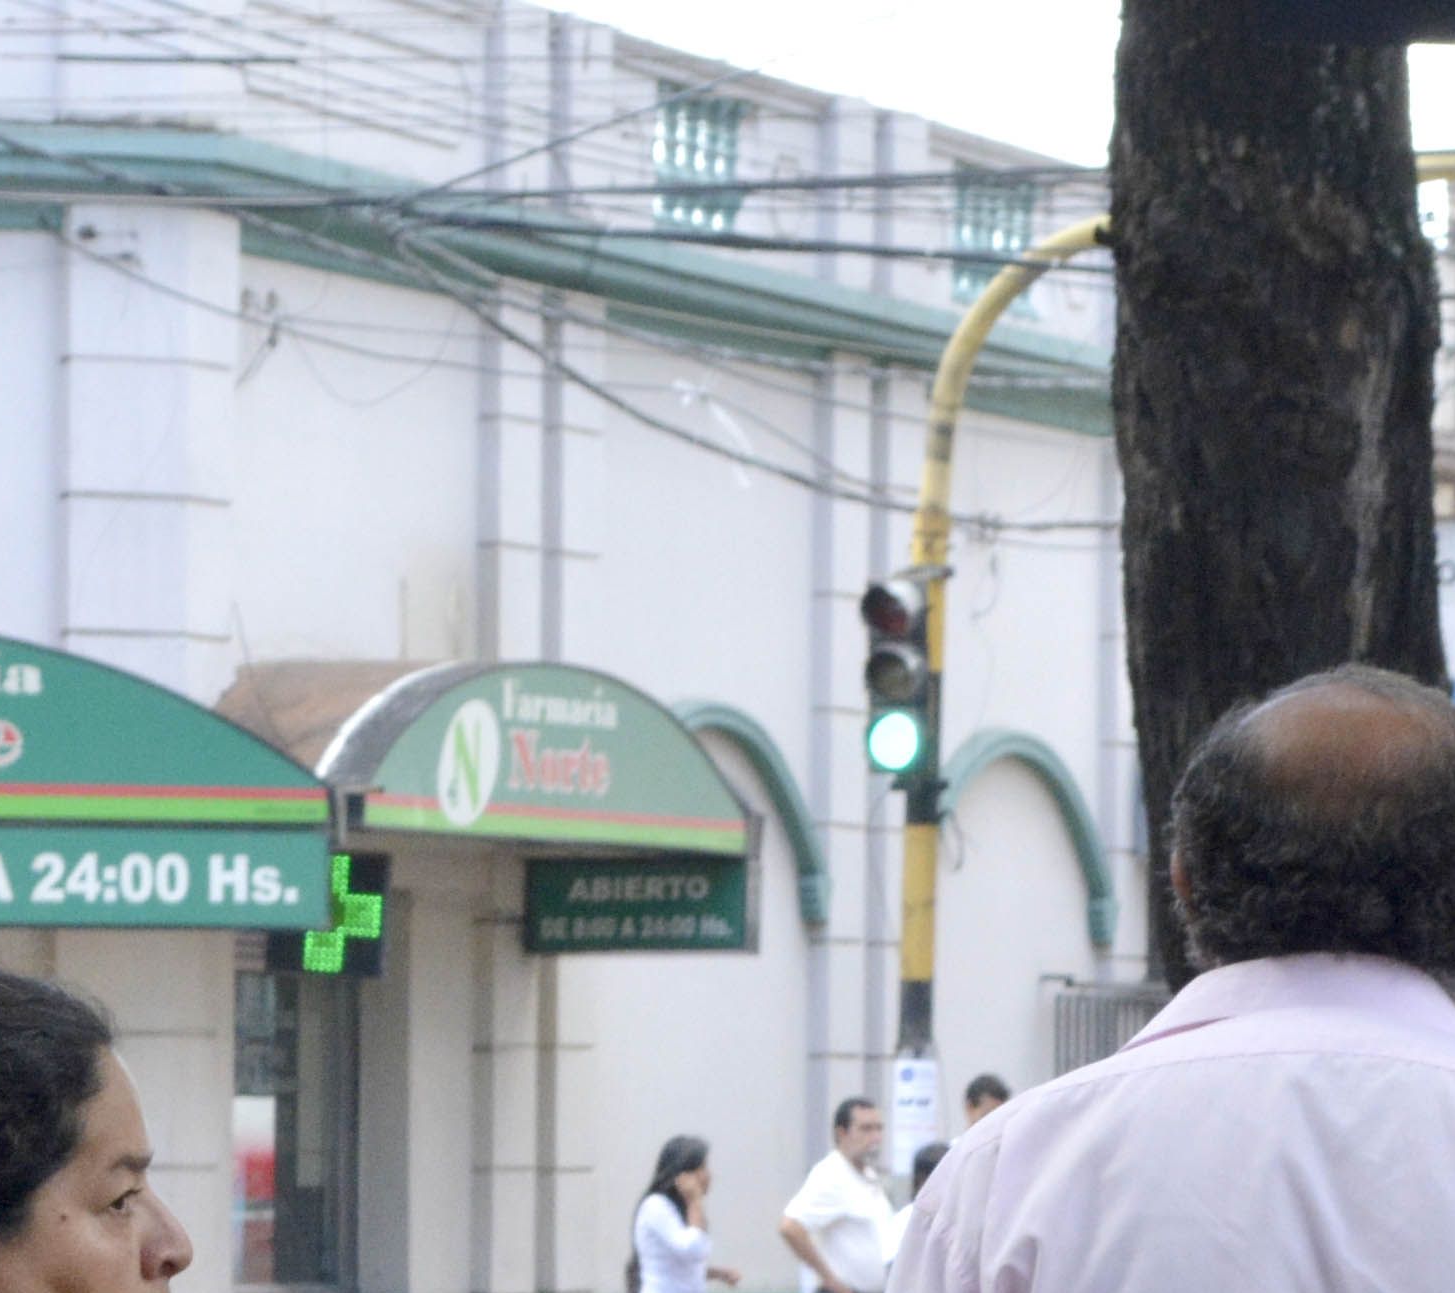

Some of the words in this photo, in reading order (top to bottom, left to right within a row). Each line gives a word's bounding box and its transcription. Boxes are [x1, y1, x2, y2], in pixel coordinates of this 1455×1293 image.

[501, 678, 619, 729] Farmacia
[506, 729, 611, 796] Norte
[31, 853, 189, 903] 24:00
[208, 855, 299, 904] Hs.
[567, 875, 711, 902] ABIERTO
